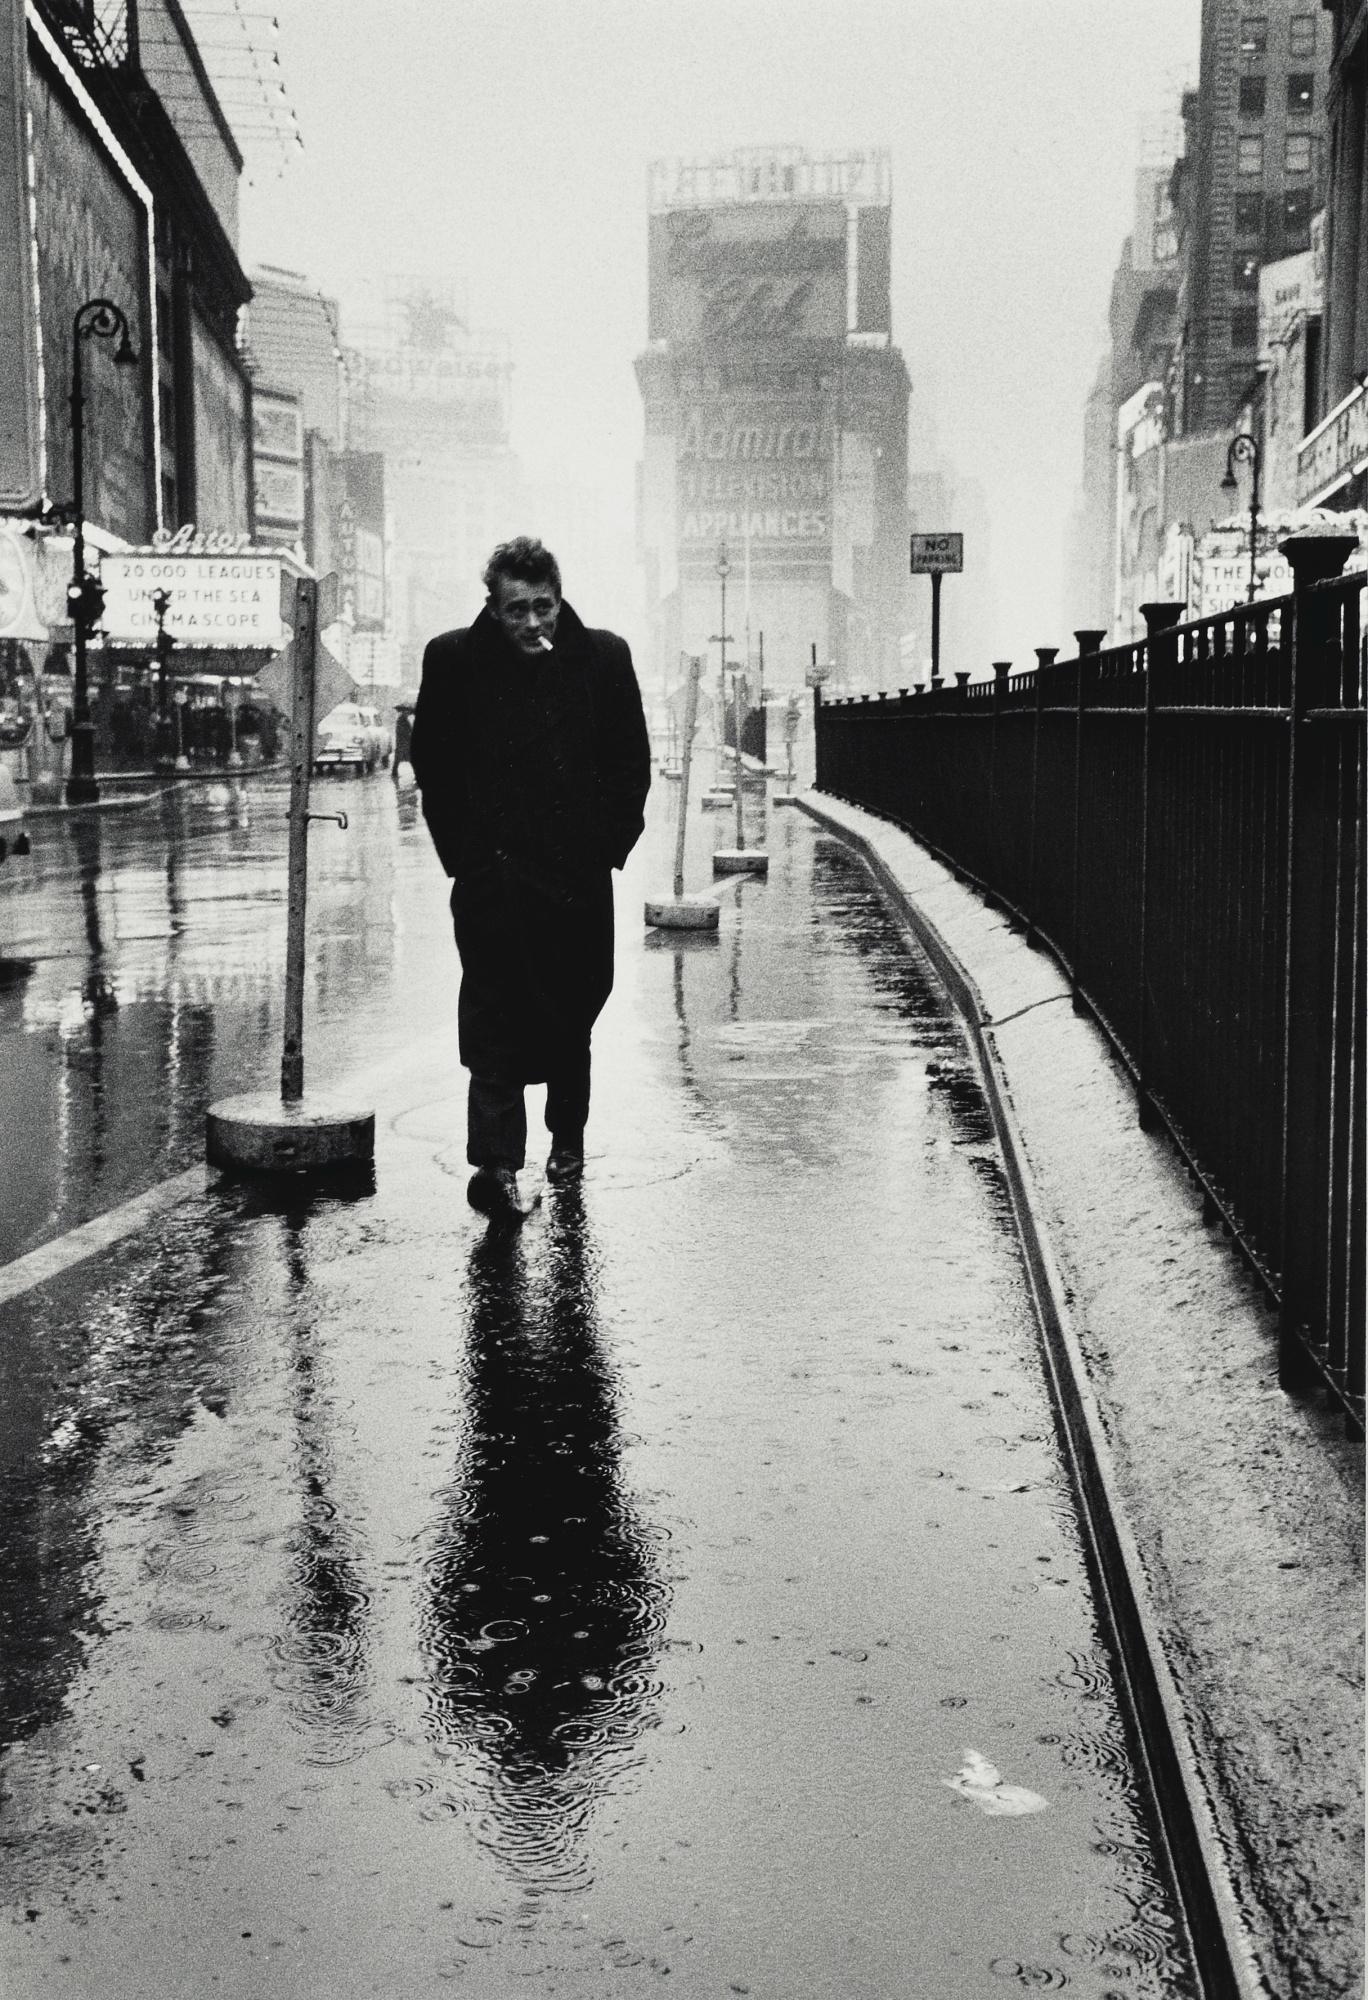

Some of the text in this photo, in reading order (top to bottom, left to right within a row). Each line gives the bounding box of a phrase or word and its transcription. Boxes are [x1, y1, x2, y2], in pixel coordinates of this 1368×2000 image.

[683, 473, 824, 500] TELEVISION
[682, 510, 824, 537] APPLIANCES
[152, 523, 251, 549] Astor
[925, 538, 949, 551] NO
[122, 564, 275, 579] 20 000 LEAGUES
[1212, 565, 1242, 580] THE
[192, 589, 221, 603] THE
[228, 589, 260, 603] SEA
